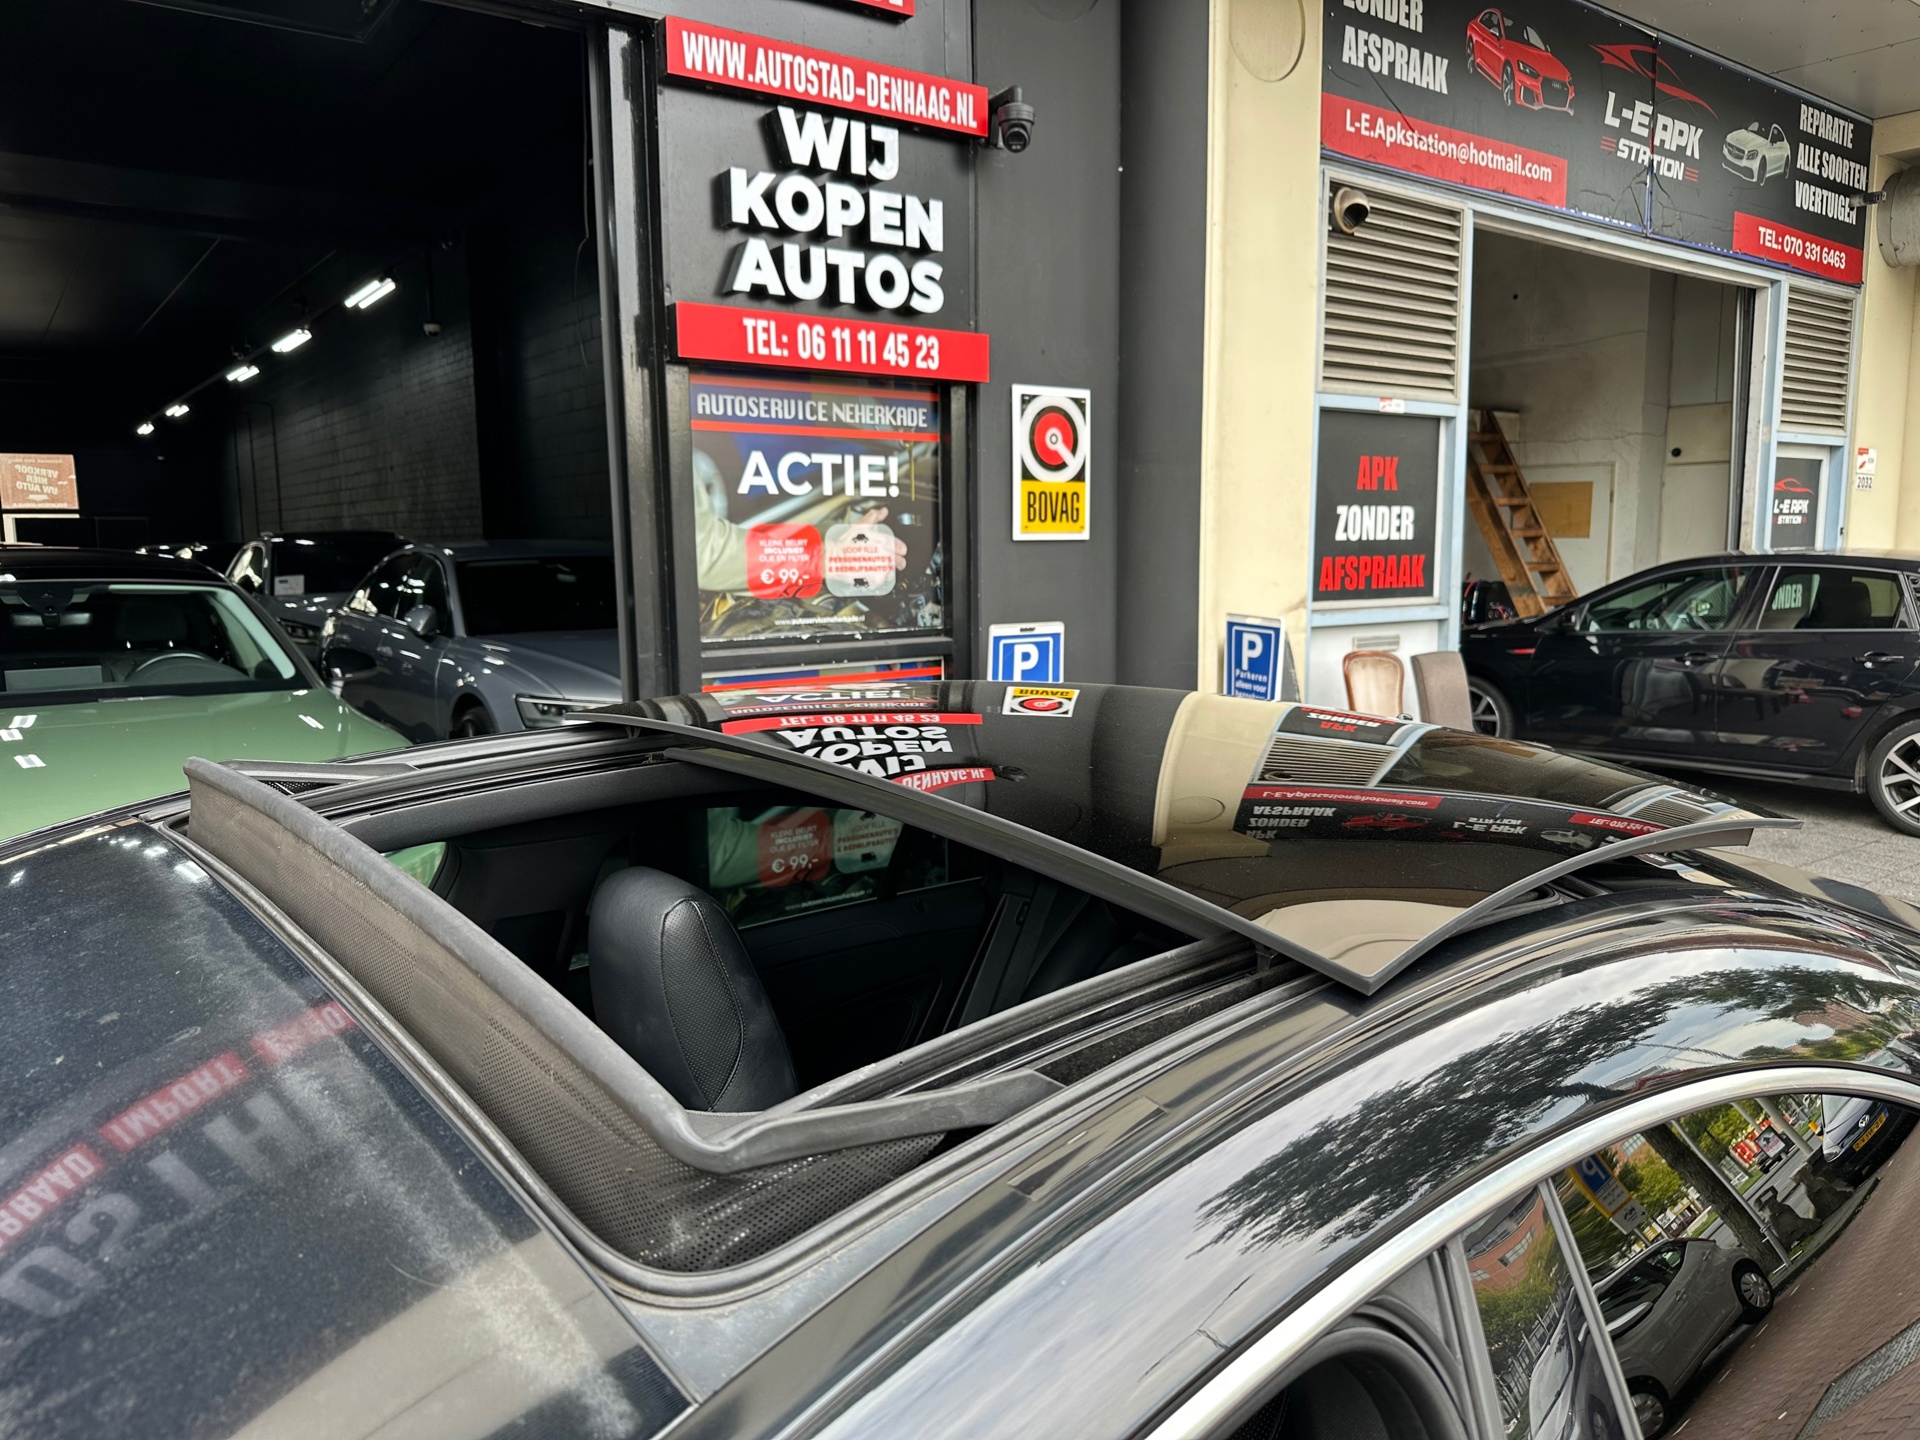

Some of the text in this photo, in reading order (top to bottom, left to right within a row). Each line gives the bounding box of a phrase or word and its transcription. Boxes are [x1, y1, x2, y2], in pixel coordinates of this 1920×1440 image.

[681, 30, 978, 128] WWW.AUTOSTAD-DENHAAG.NL
[1342, 24, 1448, 95] AFSPRAAK
[777, 105, 899, 181] WIJ
[1345, 108, 1552, 183] L-E.Apkstation@hotmail.com
[1604, 90, 1703, 160] L-E APK
[1800, 103, 1854, 149] REPARATIE
[1617, 137, 1684, 181] STATION
[1796, 142, 1867, 191] ALLE SOORTEN
[729, 166, 943, 252] KOPEN
[1758, 226, 1782, 250] TEL:
[1784, 235, 1802, 256] 070
[1804, 241, 1821, 262] 331
[1822, 247, 1846, 269] 6463
[732, 237, 945, 313] AUTOS
[743, 318, 940, 370] TEL: 06 11 11 45 23
[832, 402, 928, 428] NEHERKADE
[737, 450, 900, 498] ACTIE!
[1356, 455, 1399, 491] APK
[1857, 476, 1872, 489] 2032
[1027, 491, 1080, 524] BOVAG
[1335, 505, 1414, 541] ZONDER
[760, 568, 810, 586] € 99,-
[1318, 554, 1426, 592] AFSPRAAK
[1013, 643, 1039, 682] P
[1241, 632, 1263, 671] P
[1235, 668, 1268, 682] Parkeren
[771, 858, 785, 873] €
